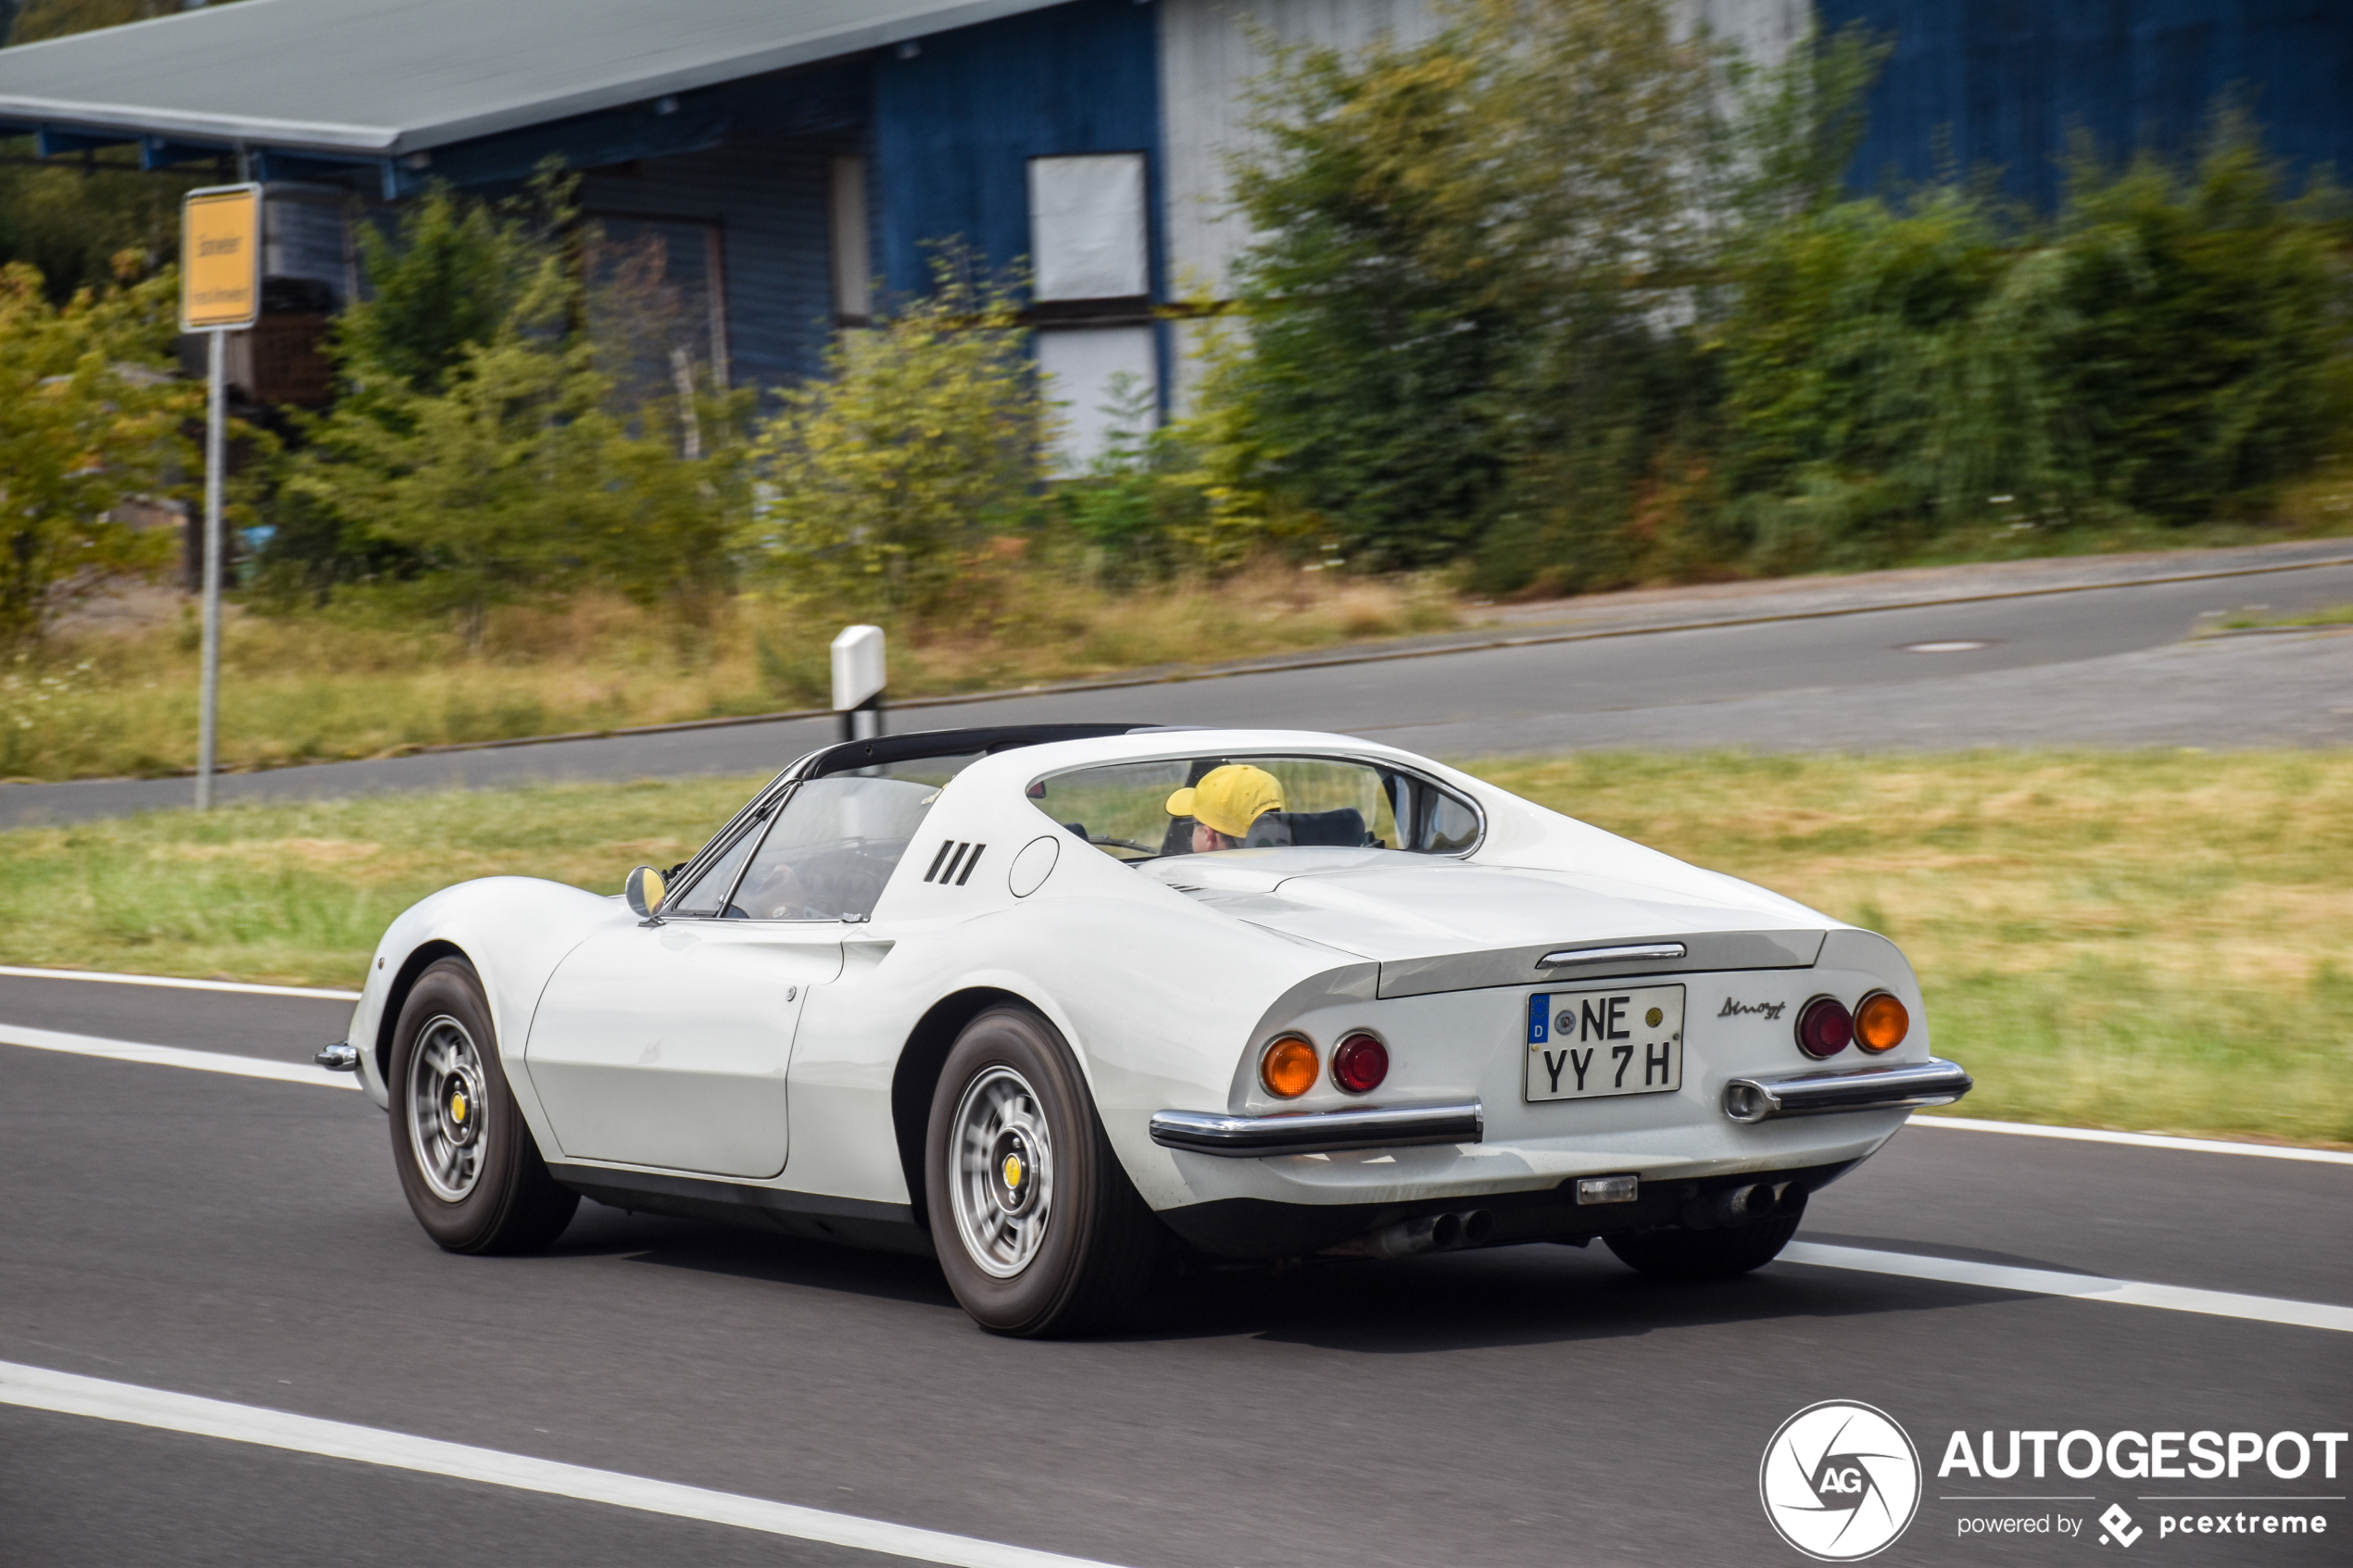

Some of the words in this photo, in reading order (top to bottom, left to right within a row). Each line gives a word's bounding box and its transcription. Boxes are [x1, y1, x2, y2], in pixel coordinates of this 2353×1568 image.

[1534, 1025, 1543, 1037] D
[1580, 996, 1630, 1042] NE
[1543, 1047, 1594, 1093] YY
[1612, 1045, 1634, 1088] 7
[1645, 1042, 1670, 1085] H
